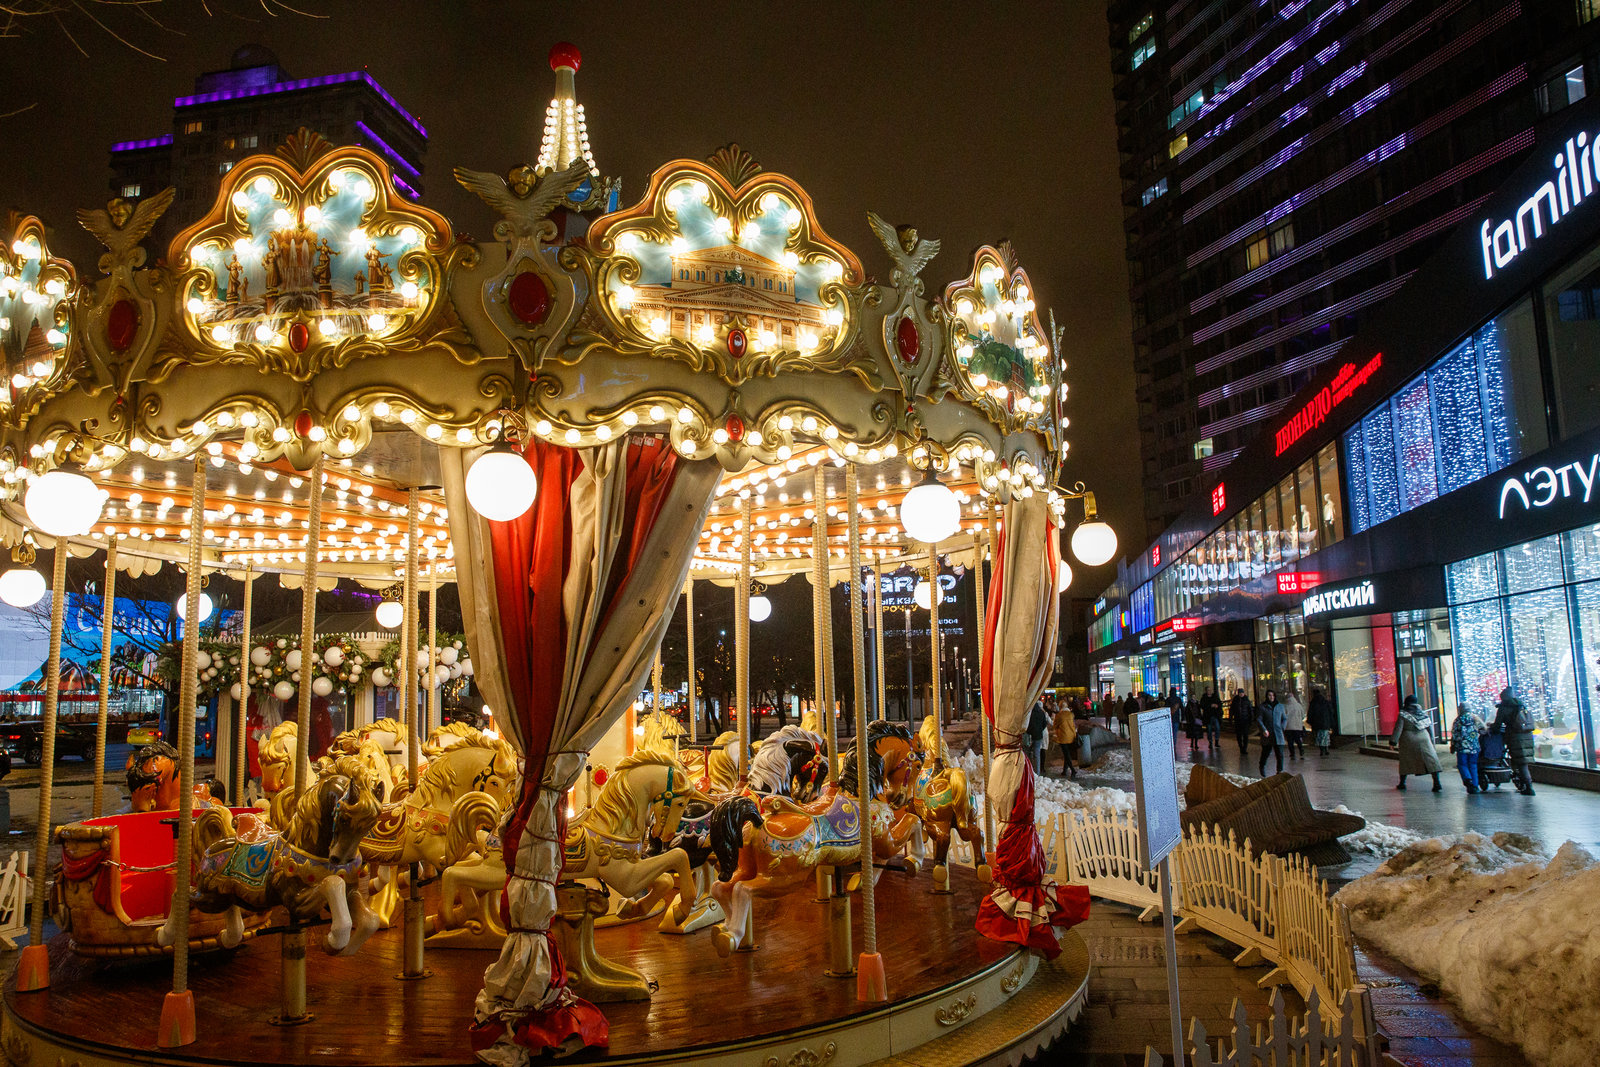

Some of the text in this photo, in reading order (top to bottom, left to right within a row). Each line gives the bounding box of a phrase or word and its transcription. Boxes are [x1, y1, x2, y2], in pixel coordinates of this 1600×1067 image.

[1333, 352, 1382, 407] гипермаркет
[1275, 387, 1332, 457] ЛЕОНАРДО
[1499, 453, 1600, 519] Л'Эту
[1279, 574, 1295, 583] UNI
[1280, 582, 1297, 592] QLO
